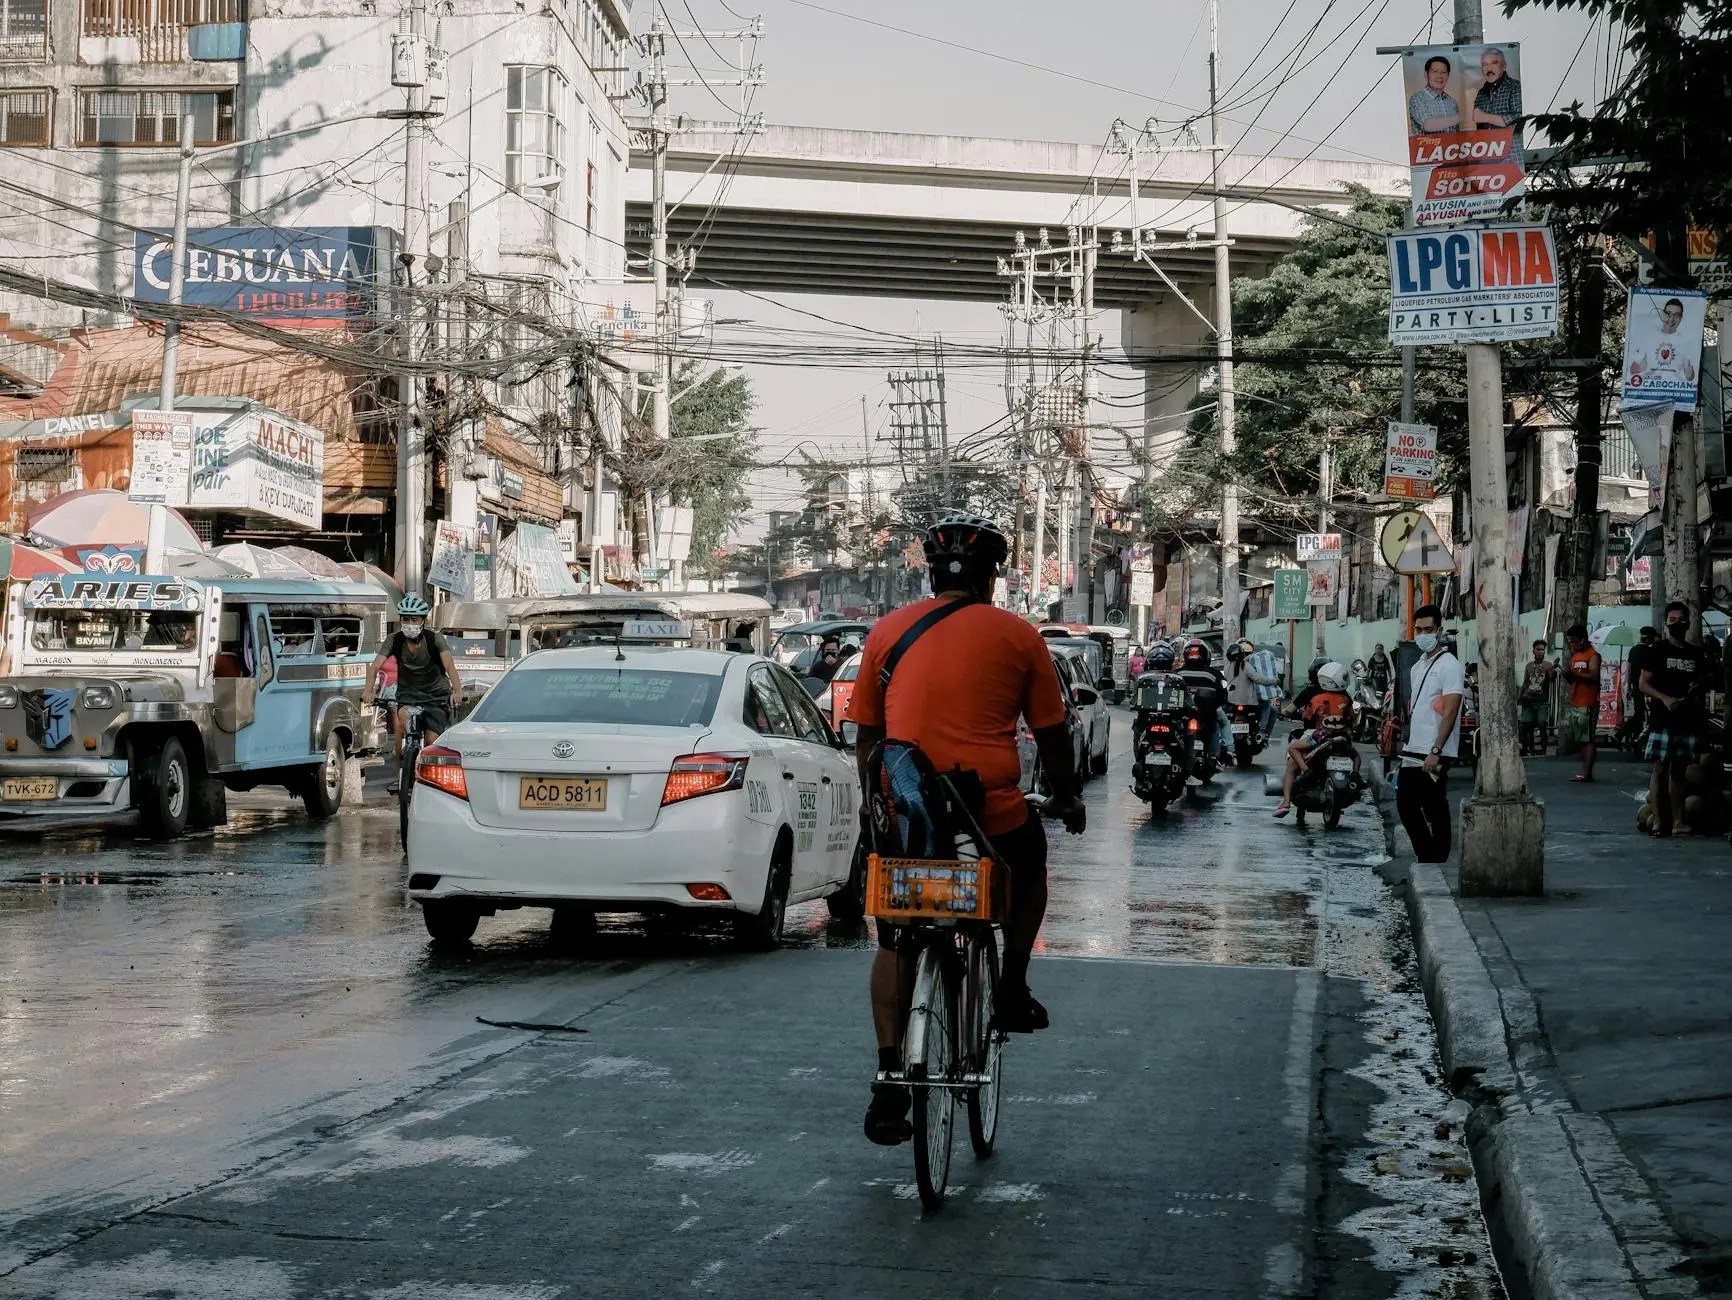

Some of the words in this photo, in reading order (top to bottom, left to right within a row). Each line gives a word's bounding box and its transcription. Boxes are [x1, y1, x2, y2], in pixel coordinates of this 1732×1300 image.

[1416, 137, 1441, 146] Ping
[1415, 141, 1506, 163] LACSON
[1437, 170, 1458, 179] Tito
[1434, 174, 1506, 196] SOTTO
[1416, 200, 1467, 213] AAYUSIN
[1416, 209, 1468, 224] AAYUSIN
[142, 233, 363, 290] CEBUANA
[1395, 233, 1471, 293] LPG
[1482, 231, 1554, 287] MA
[1395, 299, 1425, 308] LIQUEFIED
[1426, 296, 1460, 305] PETROLEUM
[1513, 291, 1554, 299] ASSOCIATION
[590, 320, 647, 330] Generika
[1642, 380, 1693, 389] CABOCHAN
[44, 413, 114, 434] DANIEL
[154, 423, 172, 431] WAY
[256, 417, 315, 466] MACHI
[1398, 435, 1415, 447] NO
[1390, 446, 1435, 460] PARKING
[1299, 536, 1320, 550] LPG
[1283, 574, 1302, 587] SM
[35, 581, 184, 602] ARIES
[1283, 587, 1301, 595] CITY
[34, 656, 72, 664] MALABON
[132, 657, 184, 666] MONUMENTO
[6, 783, 54, 795] TVK-672
[525, 785, 560, 802] ACD
[564, 785, 602, 803] 5811
[799, 793, 816, 810] 1342
